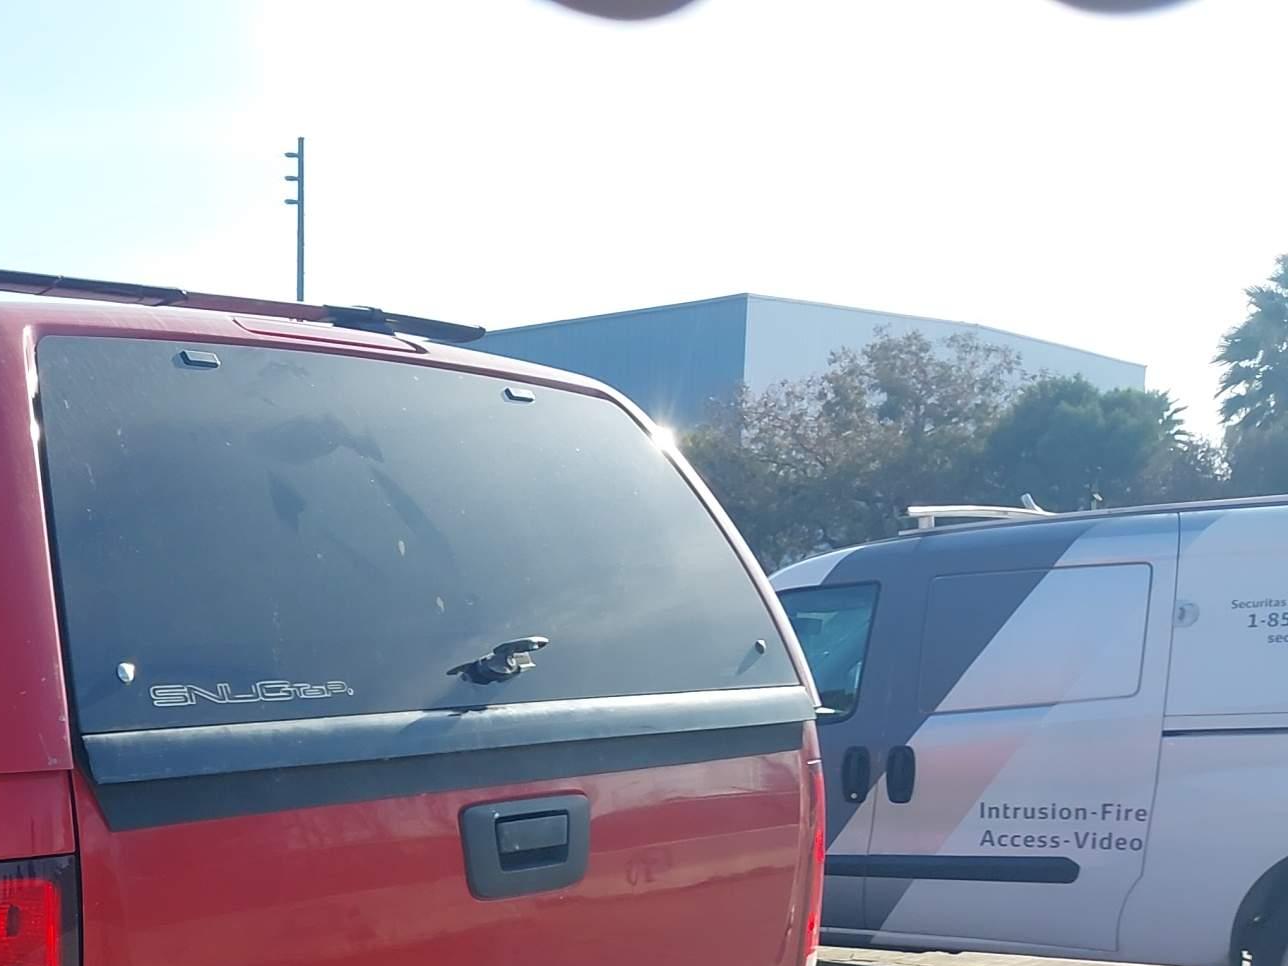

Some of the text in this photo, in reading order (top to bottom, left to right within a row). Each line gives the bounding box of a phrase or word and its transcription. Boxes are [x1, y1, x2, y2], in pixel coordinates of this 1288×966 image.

[1231, 599, 1287, 609] Securitas
[979, 802, 1148, 822] Intrusion-Fire
[979, 829, 1143, 851] Access-Video
